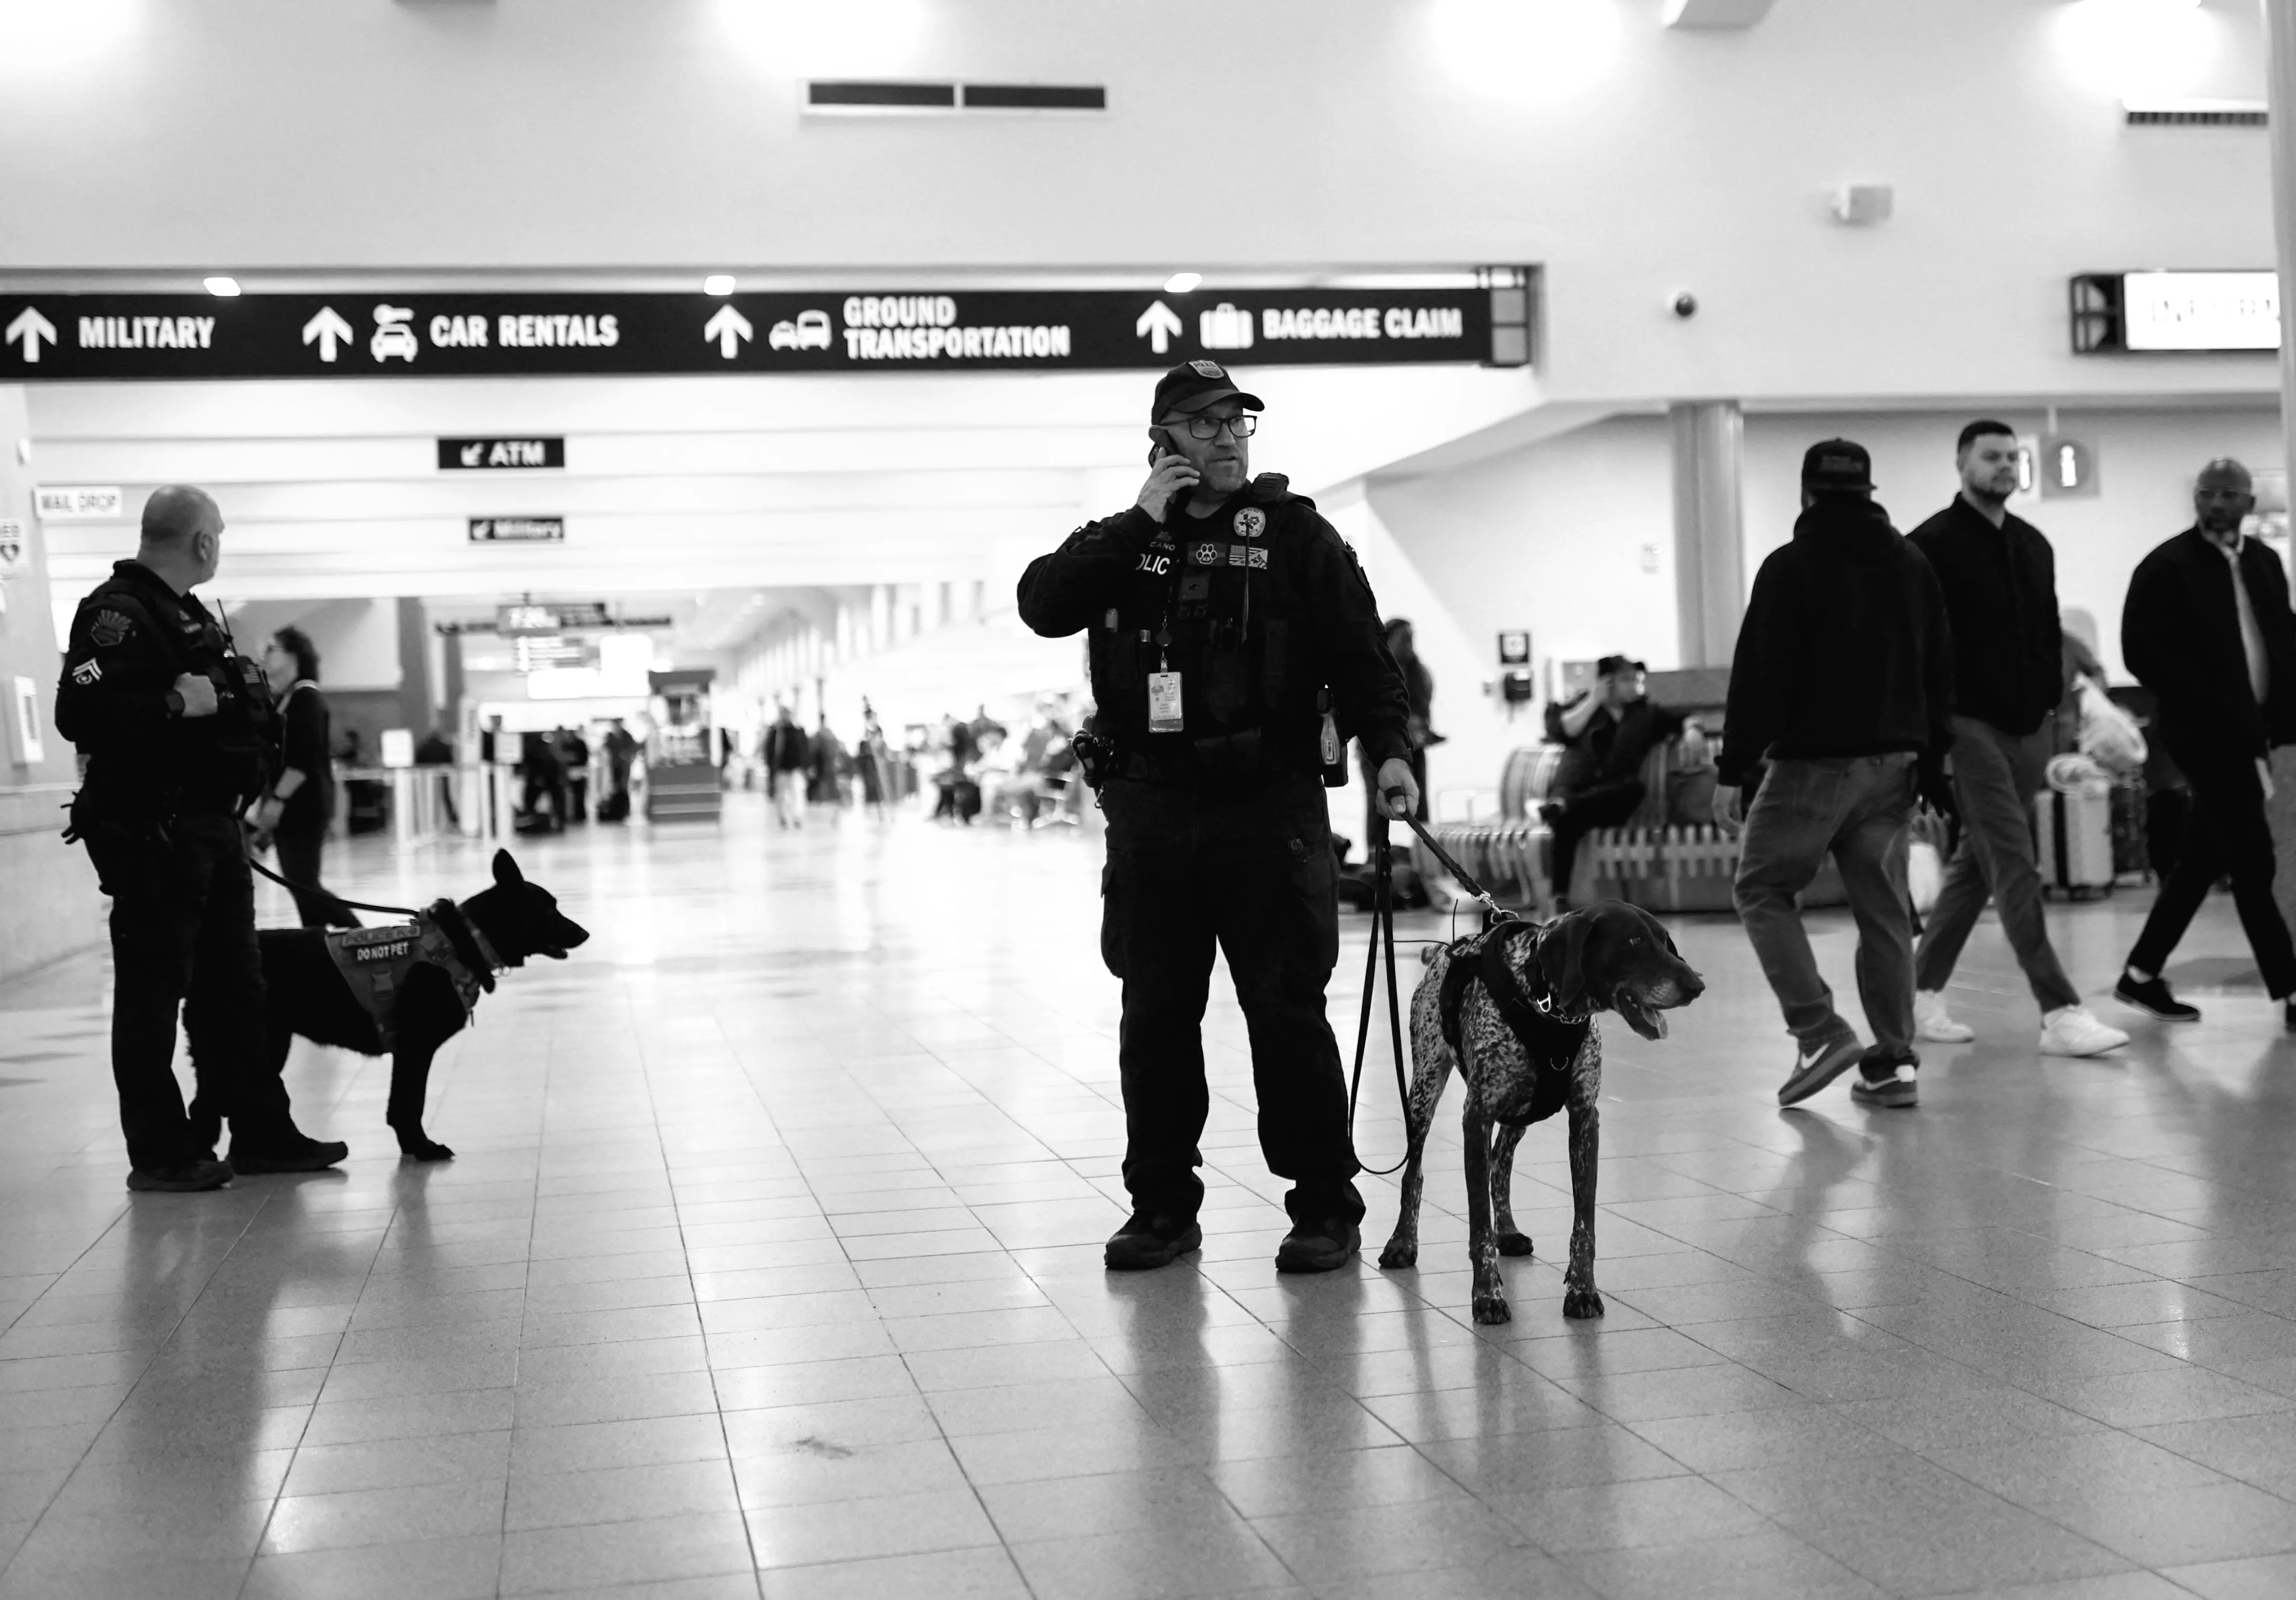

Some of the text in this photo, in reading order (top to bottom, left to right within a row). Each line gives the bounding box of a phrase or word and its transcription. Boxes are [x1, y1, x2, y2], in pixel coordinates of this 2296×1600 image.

[843, 296, 956, 327] GROUND
[1262, 308, 1462, 339] BAGGAGE CLAIM
[79, 316, 215, 348] MILITARY
[430, 315, 619, 347] CAR RENTALS
[843, 326, 1071, 359] TRANSPORTATION
[488, 441, 545, 466] ATM
[41, 494, 116, 512] MAIL DROP
[357, 942, 409, 961] DO NOT PET
